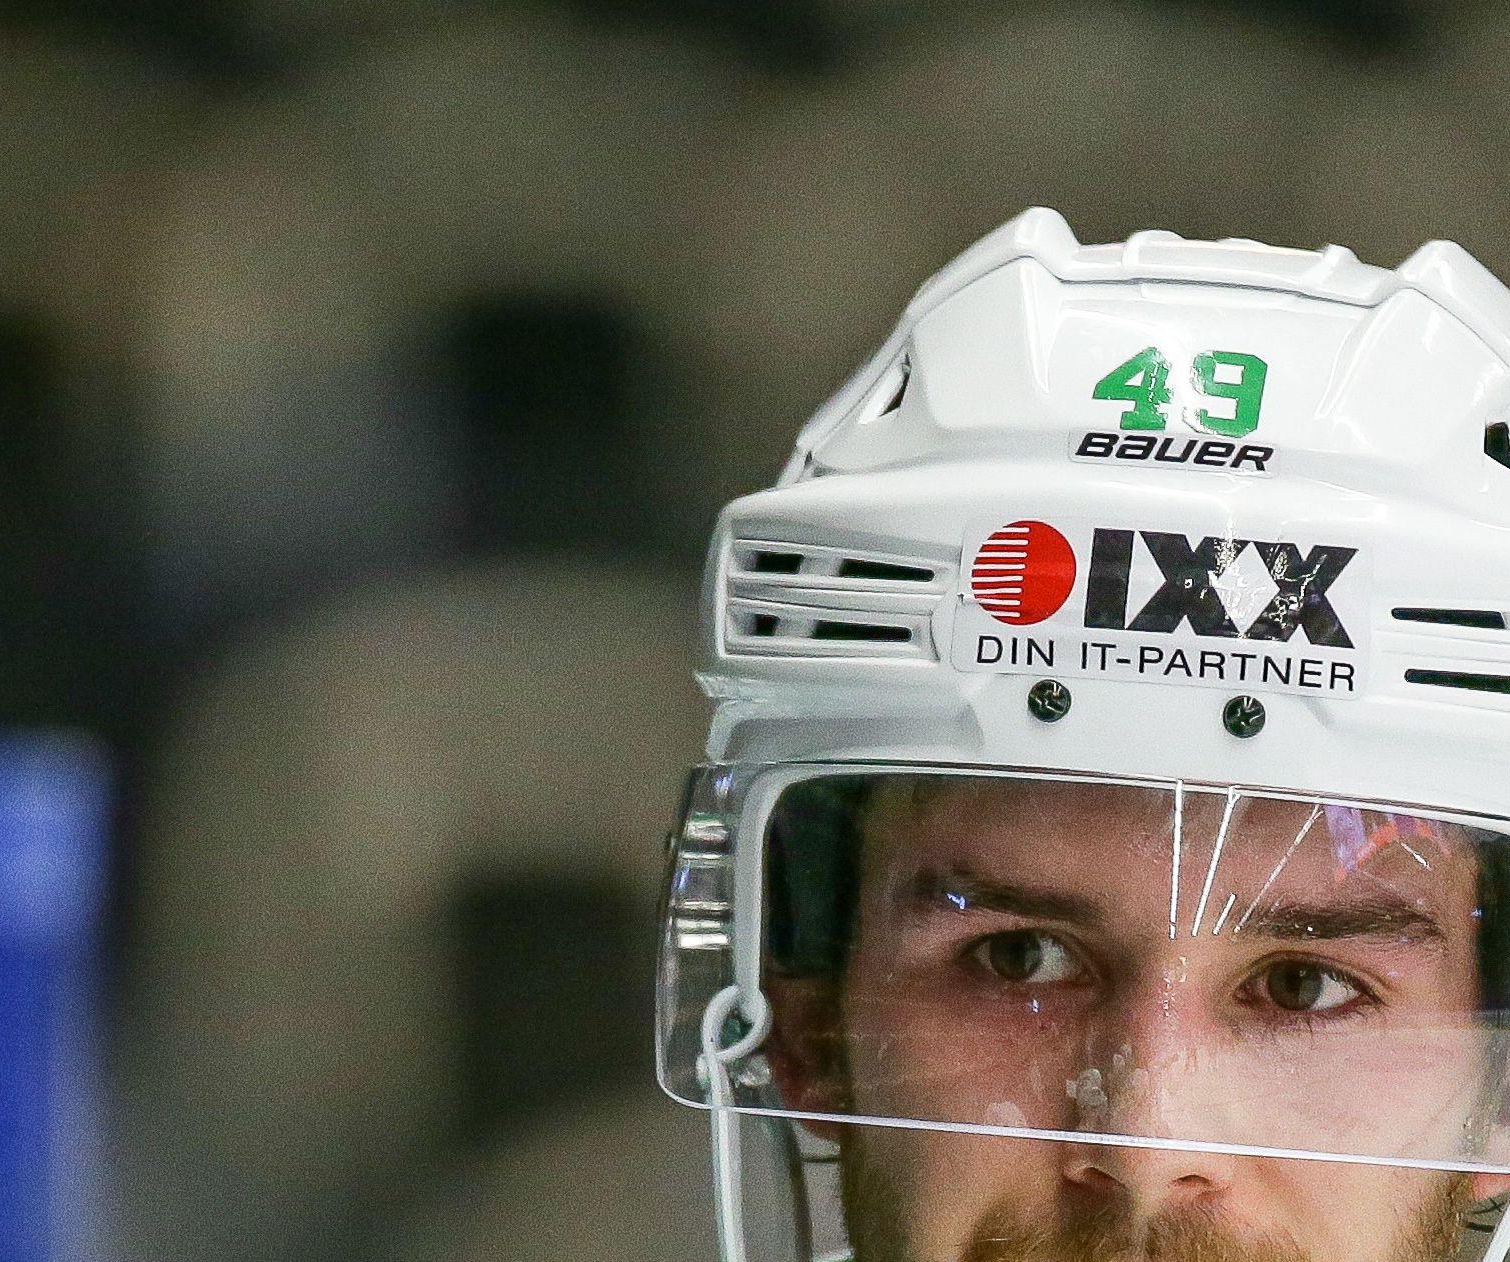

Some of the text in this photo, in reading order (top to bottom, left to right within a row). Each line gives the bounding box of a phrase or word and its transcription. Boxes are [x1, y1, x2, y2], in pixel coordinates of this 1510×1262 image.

[1092, 345, 1269, 438] 49
[1083, 526, 1360, 649] IXX
[976, 635, 1356, 693] DIN IT-PARTNER
